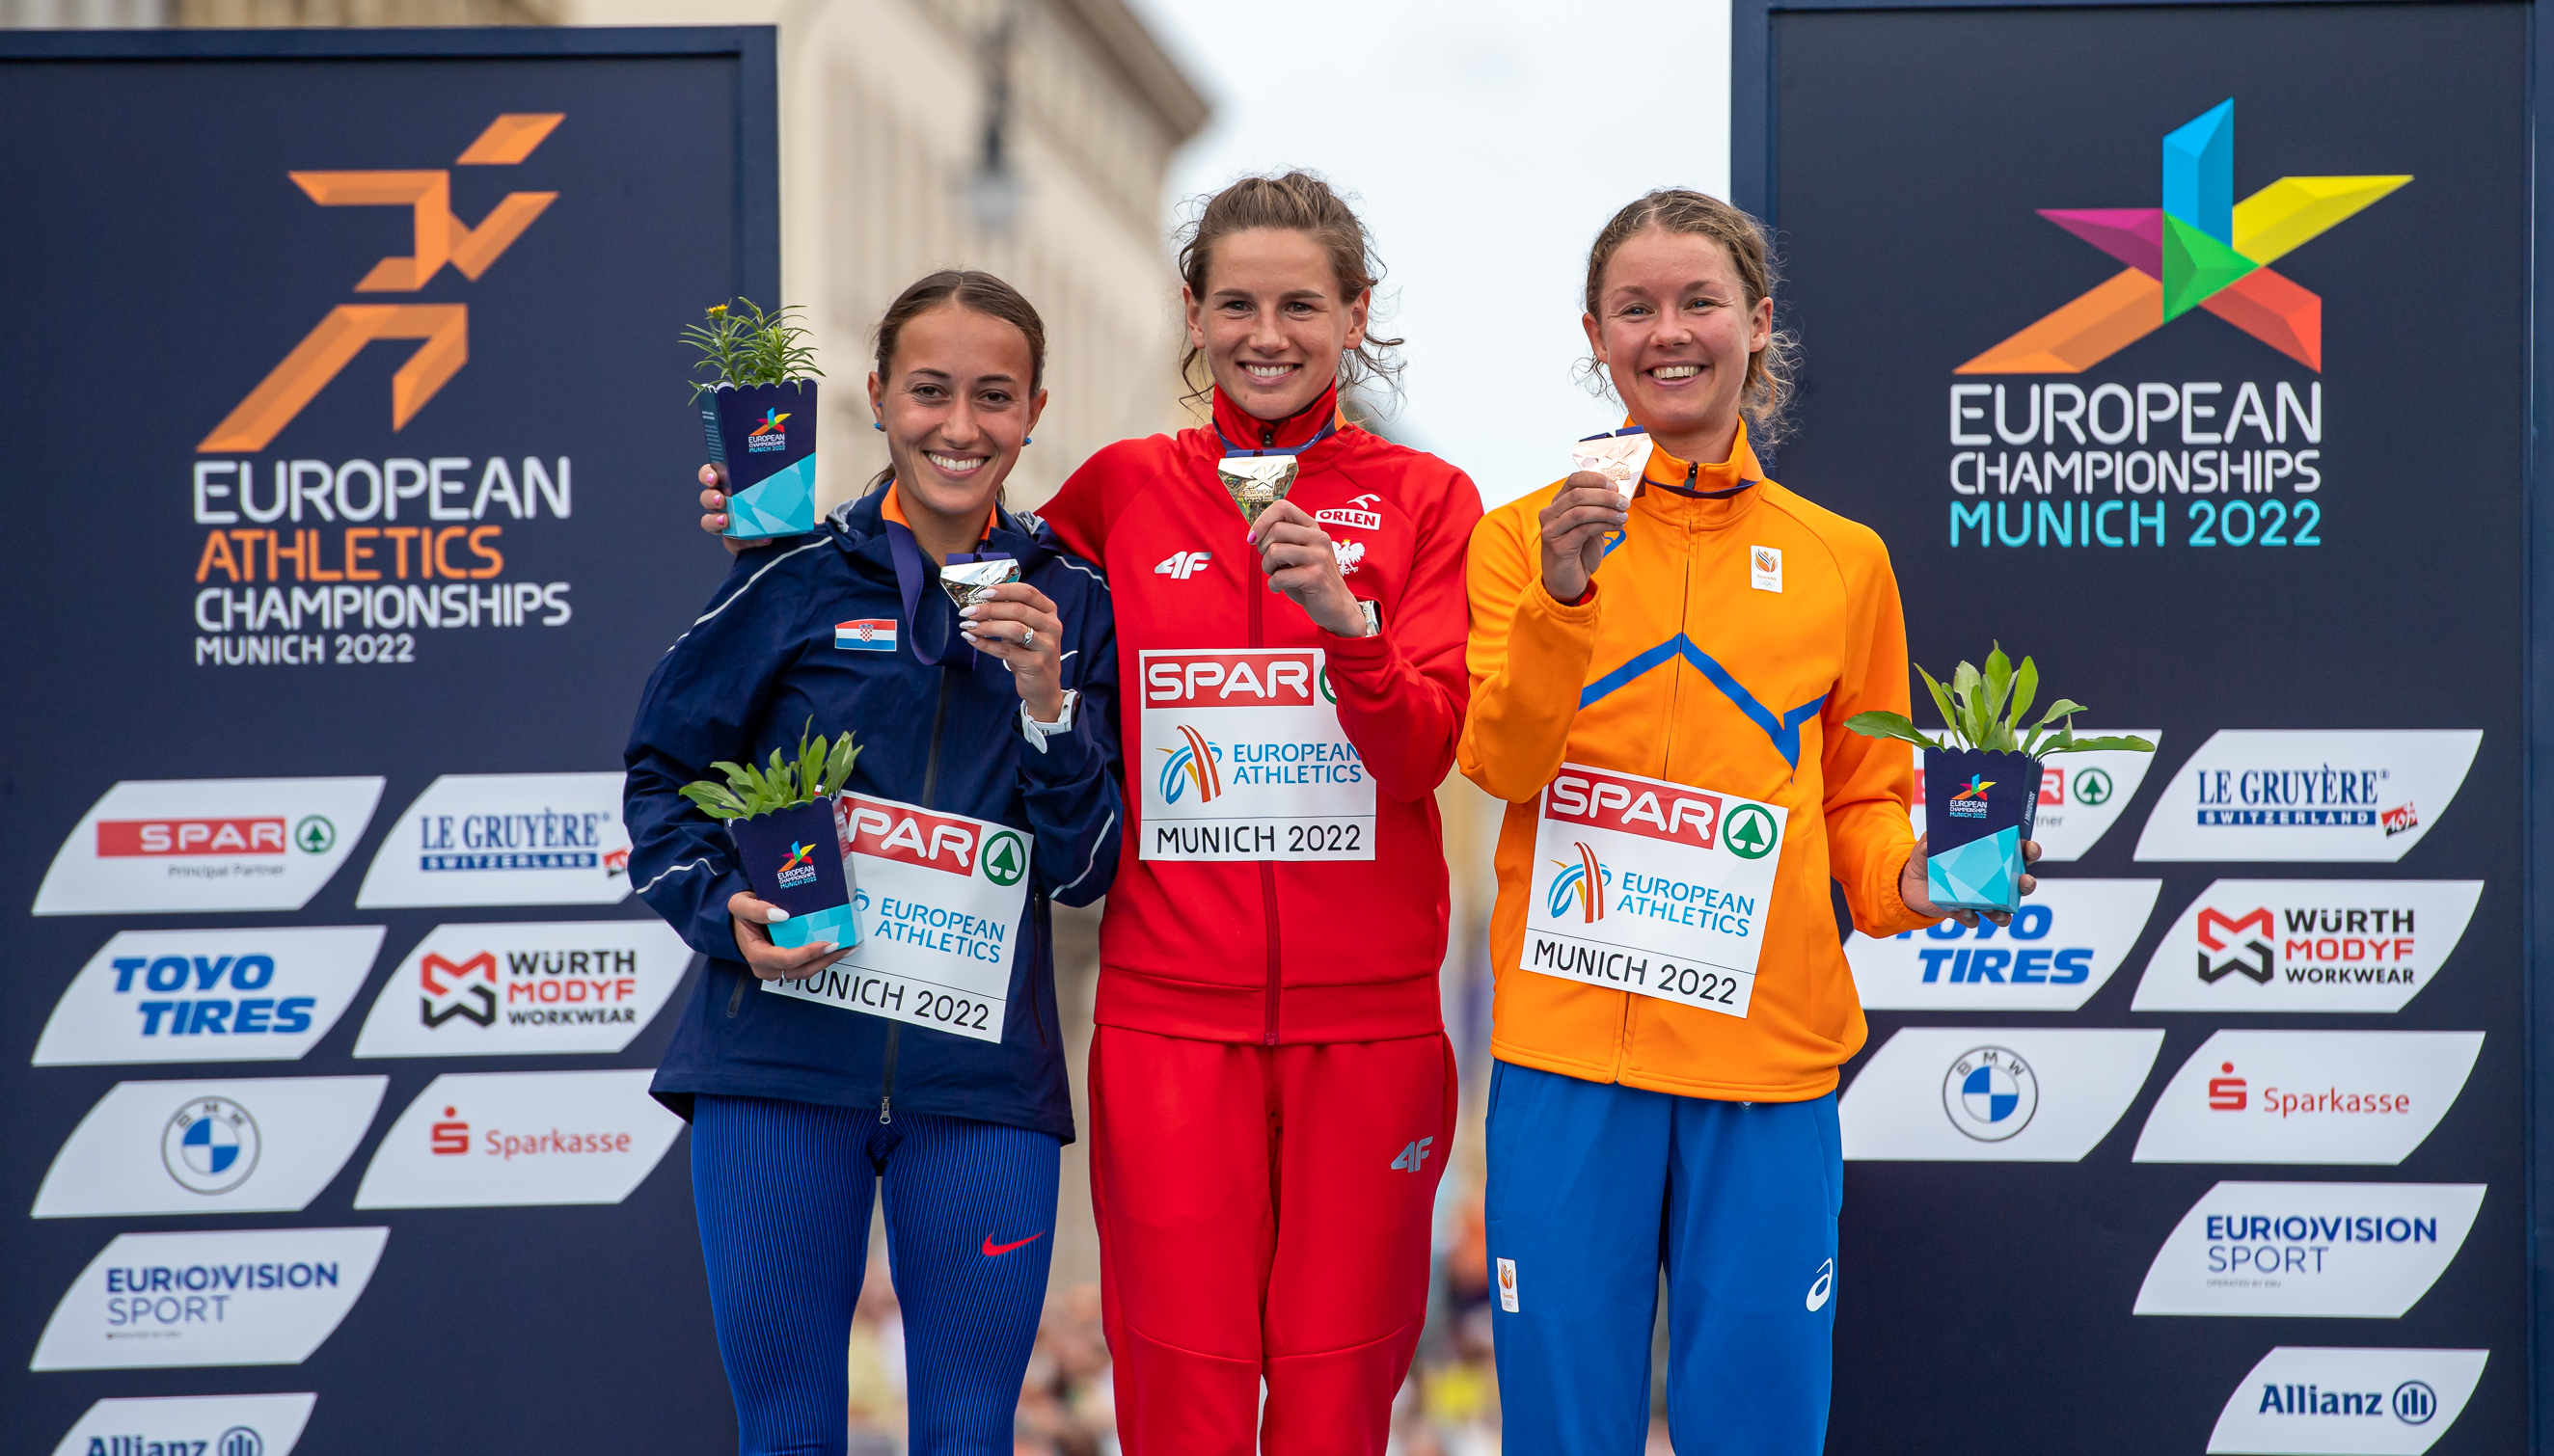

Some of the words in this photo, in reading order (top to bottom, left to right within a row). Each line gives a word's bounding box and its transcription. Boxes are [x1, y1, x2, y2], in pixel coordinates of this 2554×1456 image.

[1950, 382, 2322, 445] EUROPEAN
[1950, 449, 2322, 495] CHAMPIONSHIPS
[194, 456, 571, 524] EUROPEAN
[1319, 511, 1376, 526] ORLEN
[1950, 499, 2165, 548] MUNICH
[2188, 499, 2322, 547] 2022
[195, 526, 504, 582] ATHLETICS
[195, 582, 572, 632] CHAMPIONSHIPS
[196, 634, 325, 665] MUNICH
[335, 634, 415, 664] 2022
[1148, 661, 1309, 700] SPAR
[1234, 743, 1361, 763] EUROPEAN
[1233, 765, 1362, 784] ATHLETICS
[2197, 770, 2231, 804] LE
[1551, 775, 1714, 841] SPAR
[2205, 812, 2370, 825] SWITZERLAND
[140, 822, 283, 851] SPAR
[420, 816, 454, 849] LE
[844, 804, 973, 868] PAR
[1157, 825, 1275, 853] MUNICH
[1289, 824, 1361, 851] 2022
[168, 863, 229, 880] Principal
[233, 862, 285, 877] Partner
[427, 854, 596, 870] SWITZERLAND
[777, 865, 814, 879] EUROPEAN
[1622, 872, 1754, 916] EUROPEAN
[881, 898, 1005, 942] EUROPEAN
[1617, 894, 1751, 937] ATHLETICS
[2285, 908, 2414, 933] WÜRTH
[875, 920, 1001, 963] ATHLETICS
[2285, 938, 2414, 961] MODYF
[111, 953, 275, 993] TOYO
[506, 950, 636, 975] WÜRTH
[1534, 939, 1647, 985] MUNICH
[1658, 964, 1737, 1005] 2022
[1918, 949, 2094, 984] TIRES
[2285, 968, 2414, 984] WORKWEAR
[507, 979, 636, 1004] MODYF
[138, 997, 316, 1036] TIRES
[507, 1009, 637, 1025] WORKWEAR
[913, 990, 990, 1031] 2022
[1956, 1051, 2024, 1076] BMW
[176, 1101, 246, 1128] BMW
[2264, 1087, 2410, 1118] Sparkasse
[485, 1128, 631, 1160] Sparkasse
[2208, 1246, 2329, 1274] SPORT
[107, 1295, 230, 1326] SPORT
[2258, 1384, 2382, 1416] Allianz
